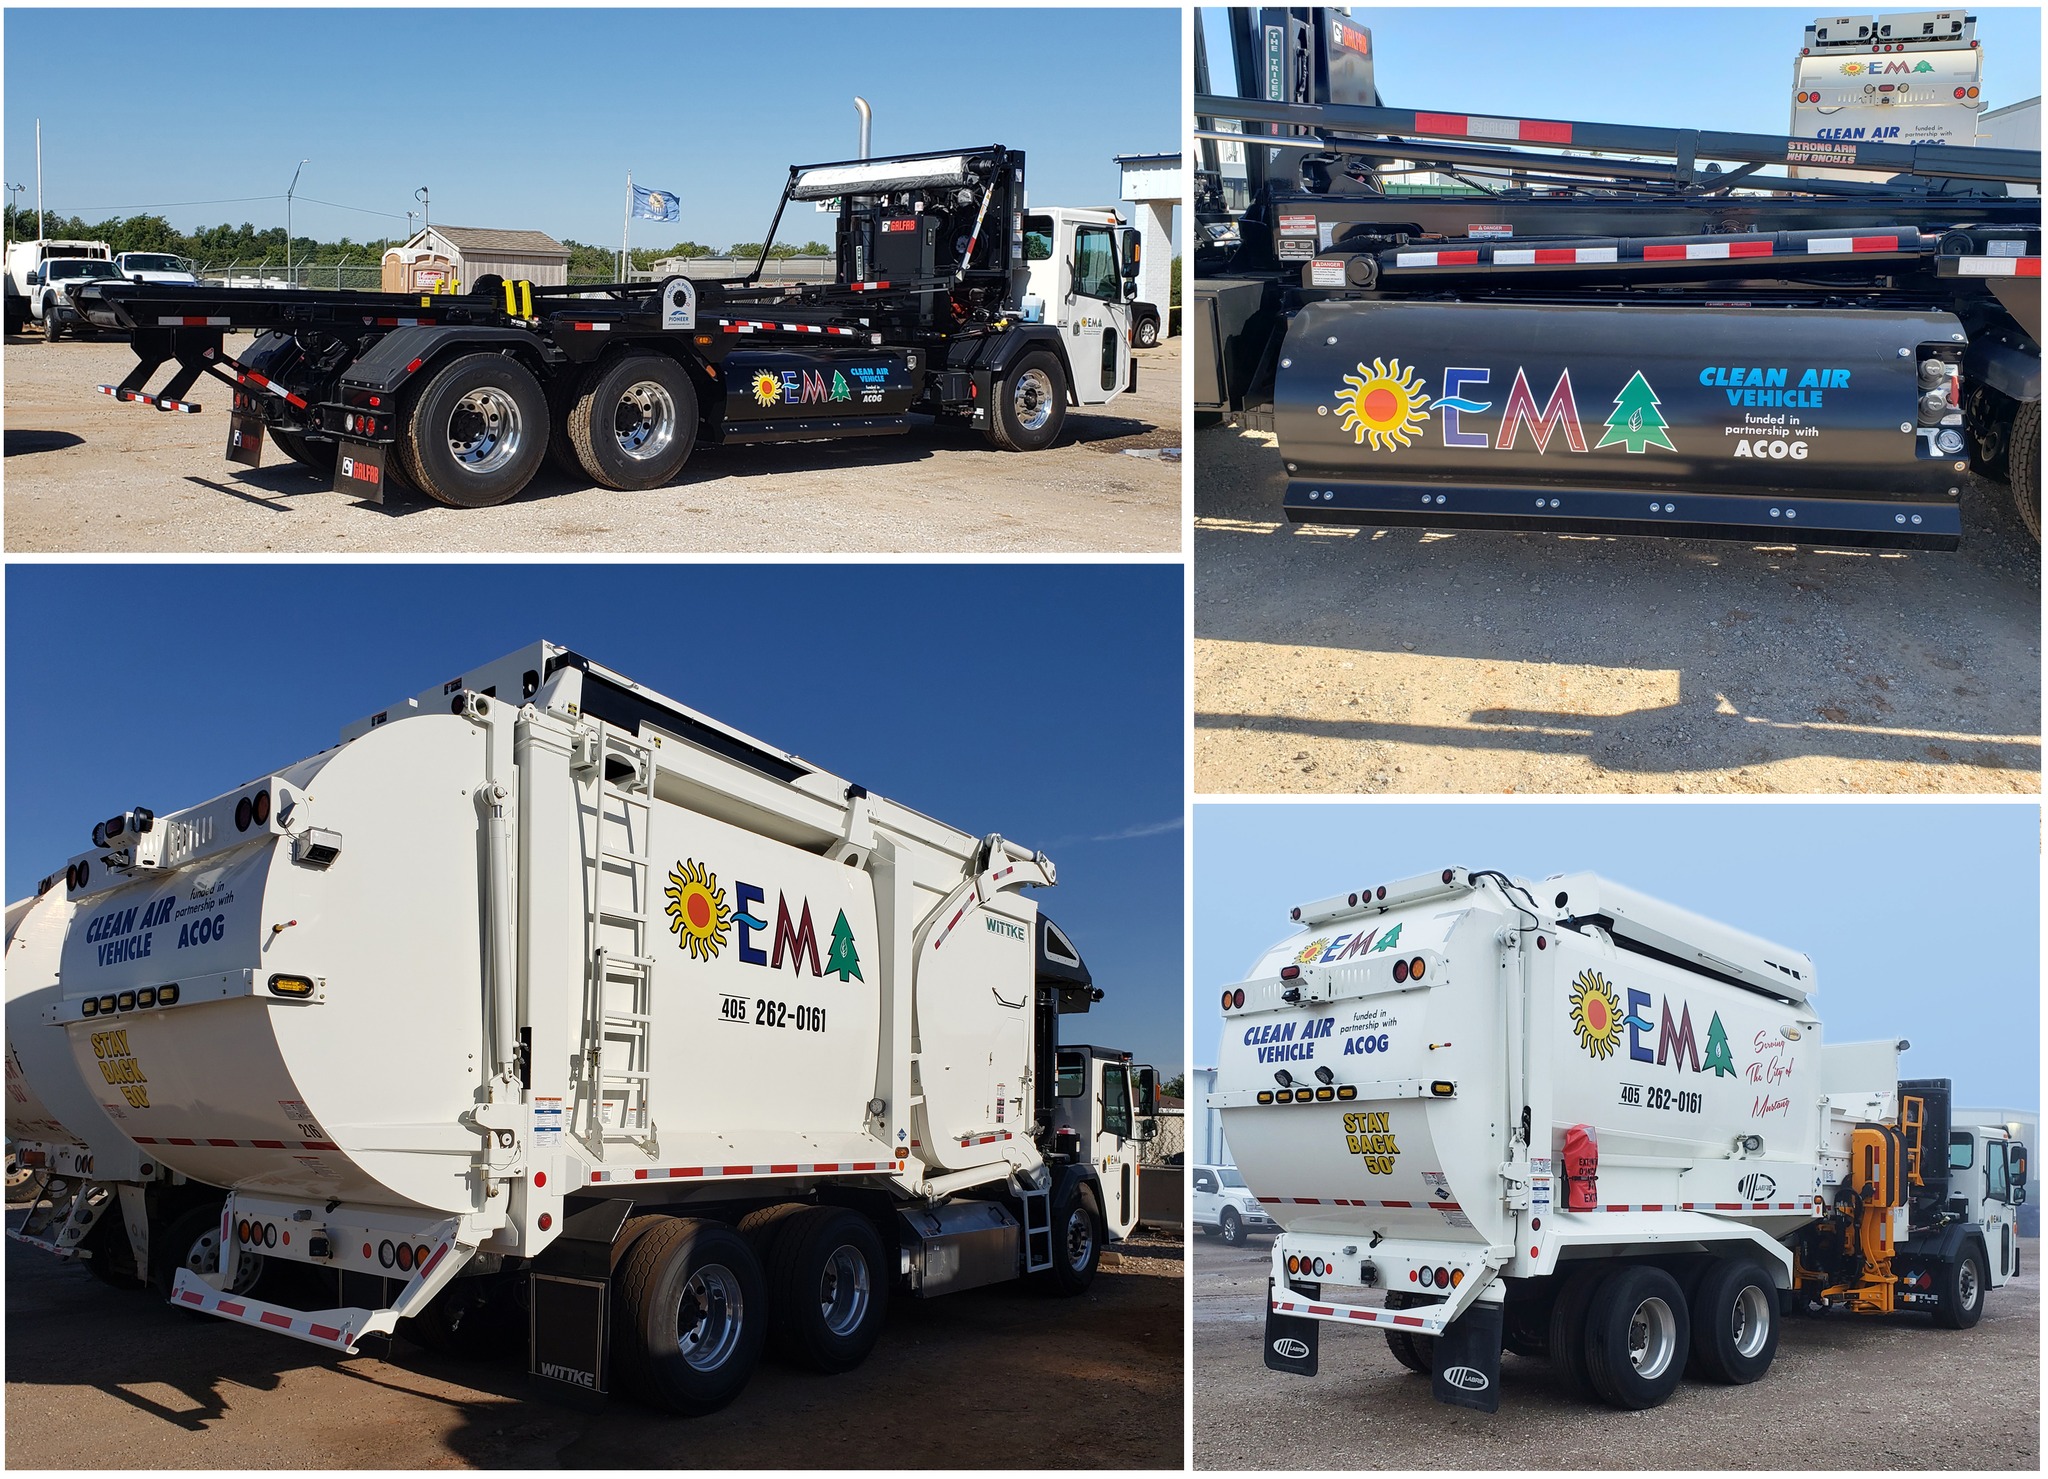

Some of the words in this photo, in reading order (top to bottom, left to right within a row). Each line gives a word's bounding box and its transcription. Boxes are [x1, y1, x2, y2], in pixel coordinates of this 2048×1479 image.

[1270, 32, 1278, 52] THE
[1343, 25, 1368, 55] GALFAB
[1271, 58, 1279, 98] TRICEP
[1817, 127, 1865, 140] CLEAN
[1871, 126, 1900, 139] AIR
[1788, 141, 1832, 152] STRONG
[1833, 144, 1856, 154] ARM
[890, 220, 915, 232] GALFAB
[850, 368, 874, 376] CLEAN
[876, 368, 889, 376] AIR
[859, 375, 885, 383] VEHICLE
[1699, 367, 1788, 387] CLEAN
[1801, 368, 1851, 388] AIR
[863, 395, 882, 403] ACOG
[1725, 388, 1823, 408] VEHICLE
[1745, 412, 1785, 425] funded
[1790, 414, 1800, 425] in
[1725, 425, 1790, 438] partnership
[1795, 425, 1819, 437] with
[1733, 439, 1809, 459] ACOG
[353, 461, 379, 484] GALFAB
[217, 880, 225, 893] in
[174, 897, 216, 921] partnership
[218, 893, 234, 908] with
[86, 906, 139, 944] CLEAN
[140, 895, 176, 930] AIR
[177, 914, 225, 950] ACOG
[98, 932, 153, 967] VEHICLE
[721, 998, 746, 1020] 405
[755, 999, 826, 1033] 262-0161
[1353, 1010, 1378, 1022] funded
[1380, 1009, 1387, 1017] in
[1244, 1021, 1297, 1046] CLEAN
[1300, 1017, 1336, 1040] AIR
[1340, 1021, 1380, 1035] partnership
[1382, 1018, 1398, 1028] with
[90, 1029, 131, 1059] STAY
[1257, 1042, 1315, 1064] VEHICLE
[1344, 1034, 1389, 1056] ACOG
[1754, 1030, 1786, 1056] Serving
[98, 1058, 148, 1085] BACK
[1745, 1062, 1763, 1085] The
[1767, 1056, 1786, 1086] City
[1785, 1057, 1794, 1077] of
[120, 1085, 150, 1109] 50'
[1621, 1086, 1640, 1104] 405
[1647, 1087, 1702, 1114] 262-0161
[1752, 1094, 1790, 1119] Mustang
[298, 1123, 323, 1138] 216
[1343, 1112, 1390, 1133] STAY
[1346, 1134, 1401, 1155] BACK
[1364, 1156, 1396, 1175] 50'
